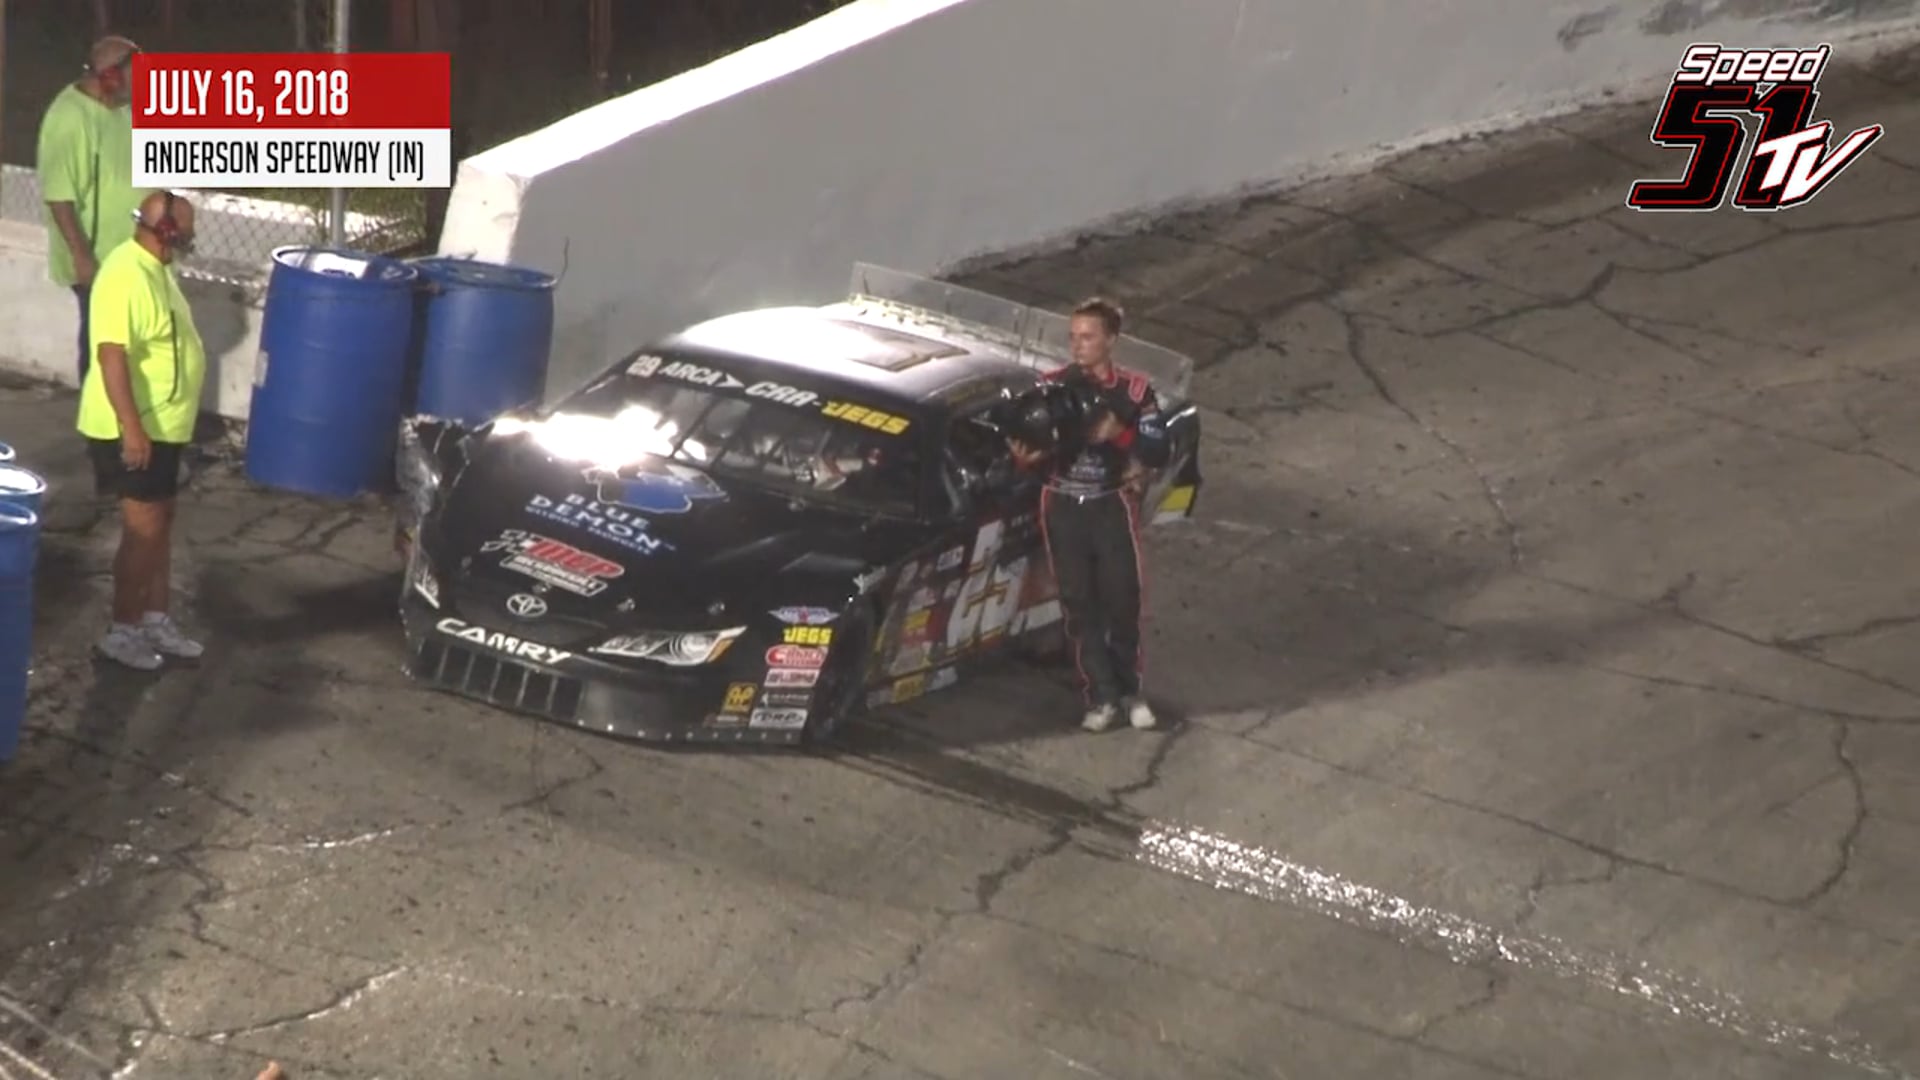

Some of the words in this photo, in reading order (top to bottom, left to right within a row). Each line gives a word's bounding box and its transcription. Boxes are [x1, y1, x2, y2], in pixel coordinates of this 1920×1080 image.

[657, 361, 723, 386] ARCA
[820, 400, 911, 436] JEGS
[529, 494, 662, 550] DEMON
[565, 493, 650, 530] BLUE
[436, 617, 572, 664] CAMRY
[783, 626, 833, 646] JEGS
